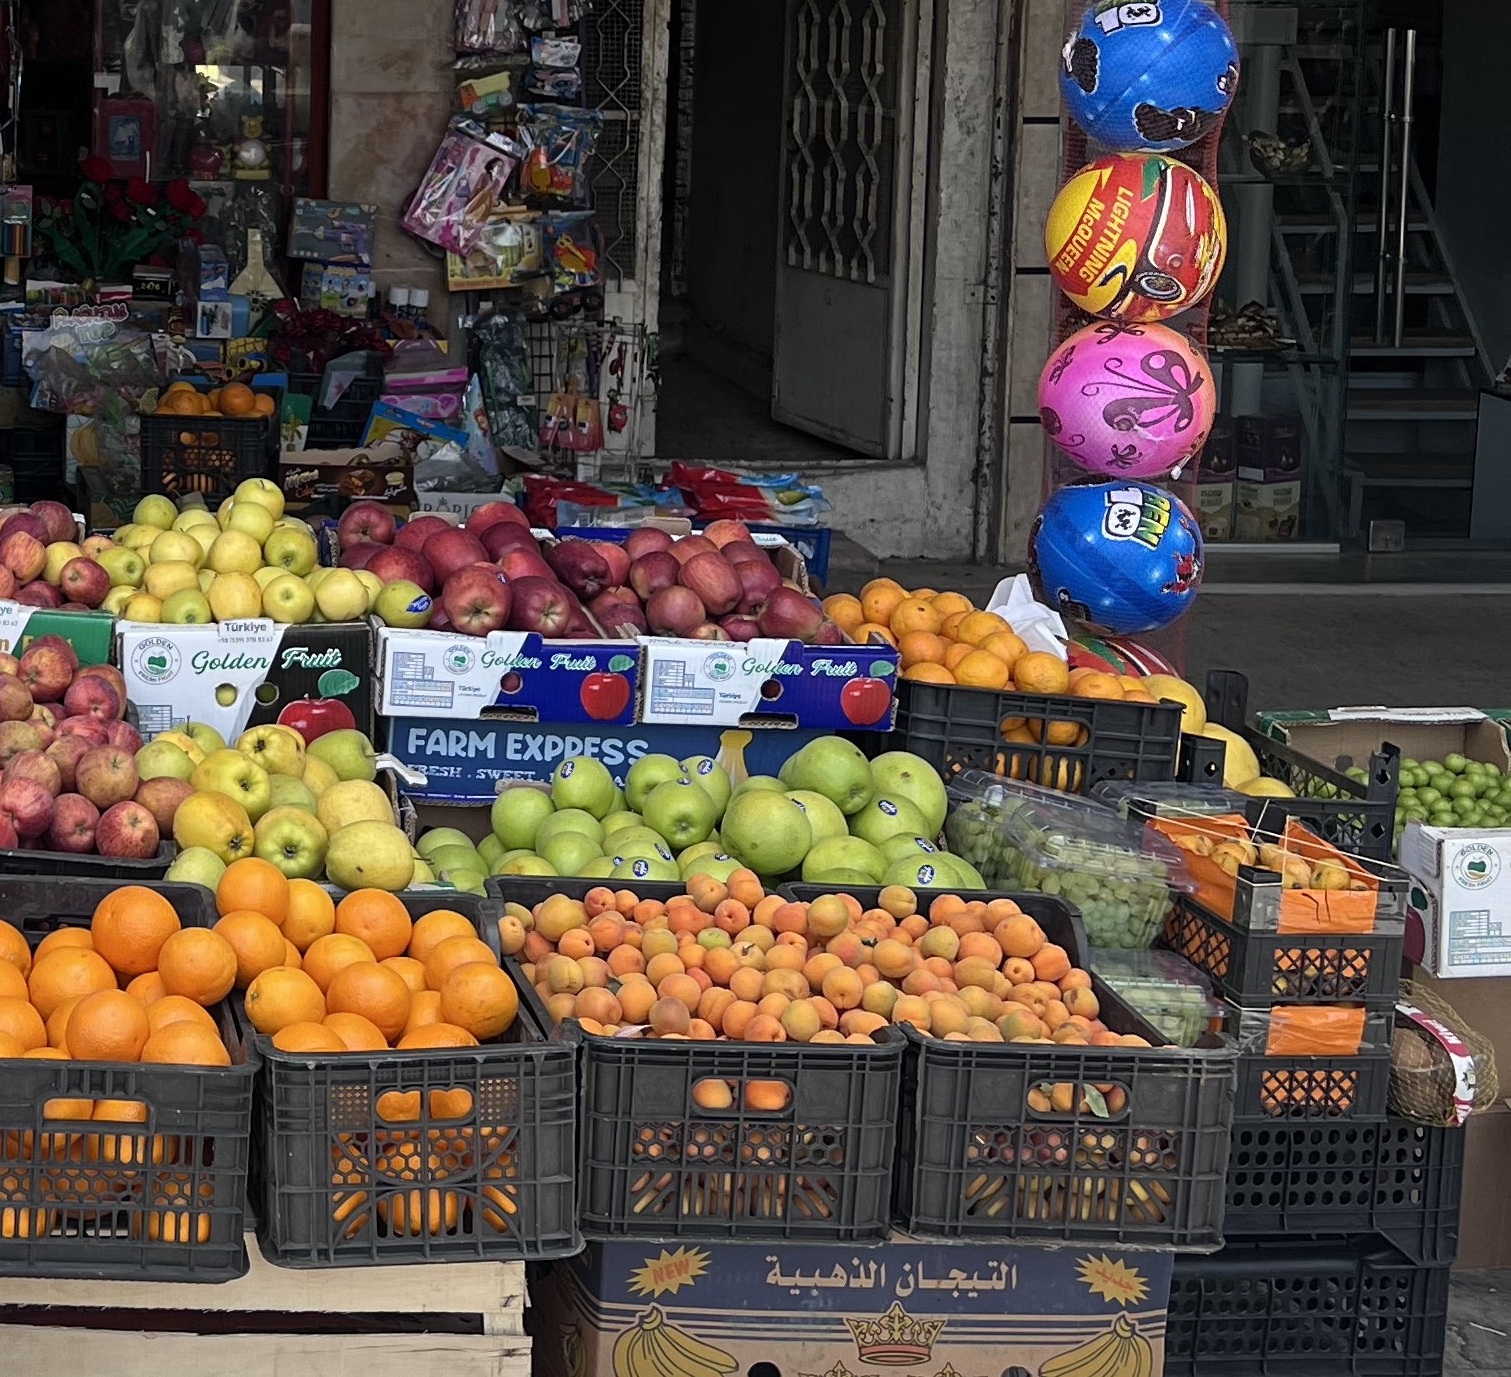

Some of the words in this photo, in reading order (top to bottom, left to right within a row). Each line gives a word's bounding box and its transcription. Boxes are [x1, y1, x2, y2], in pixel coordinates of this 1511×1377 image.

[1078, 185, 1134, 283] LIGHTNING
[1137, 490, 1171, 547] BEN
[225, 622, 267, 633] Türkiye
[139, 636, 175, 651] GOLDEN
[191, 649, 270, 675] Golden
[280, 646, 343, 670] Fruit
[480, 650, 543, 670] Golden
[549, 652, 598, 672] Fruit
[741, 657, 804, 676] Golden
[809, 659, 858, 677] Fruit
[406, 727, 497, 760] FARM
[505, 732, 649, 767] EXPRESS
[652, 1257, 689, 1286] NEW
[765, 1254, 886, 1297] الذهبية
[894, 1259, 1017, 1298] التيجان
